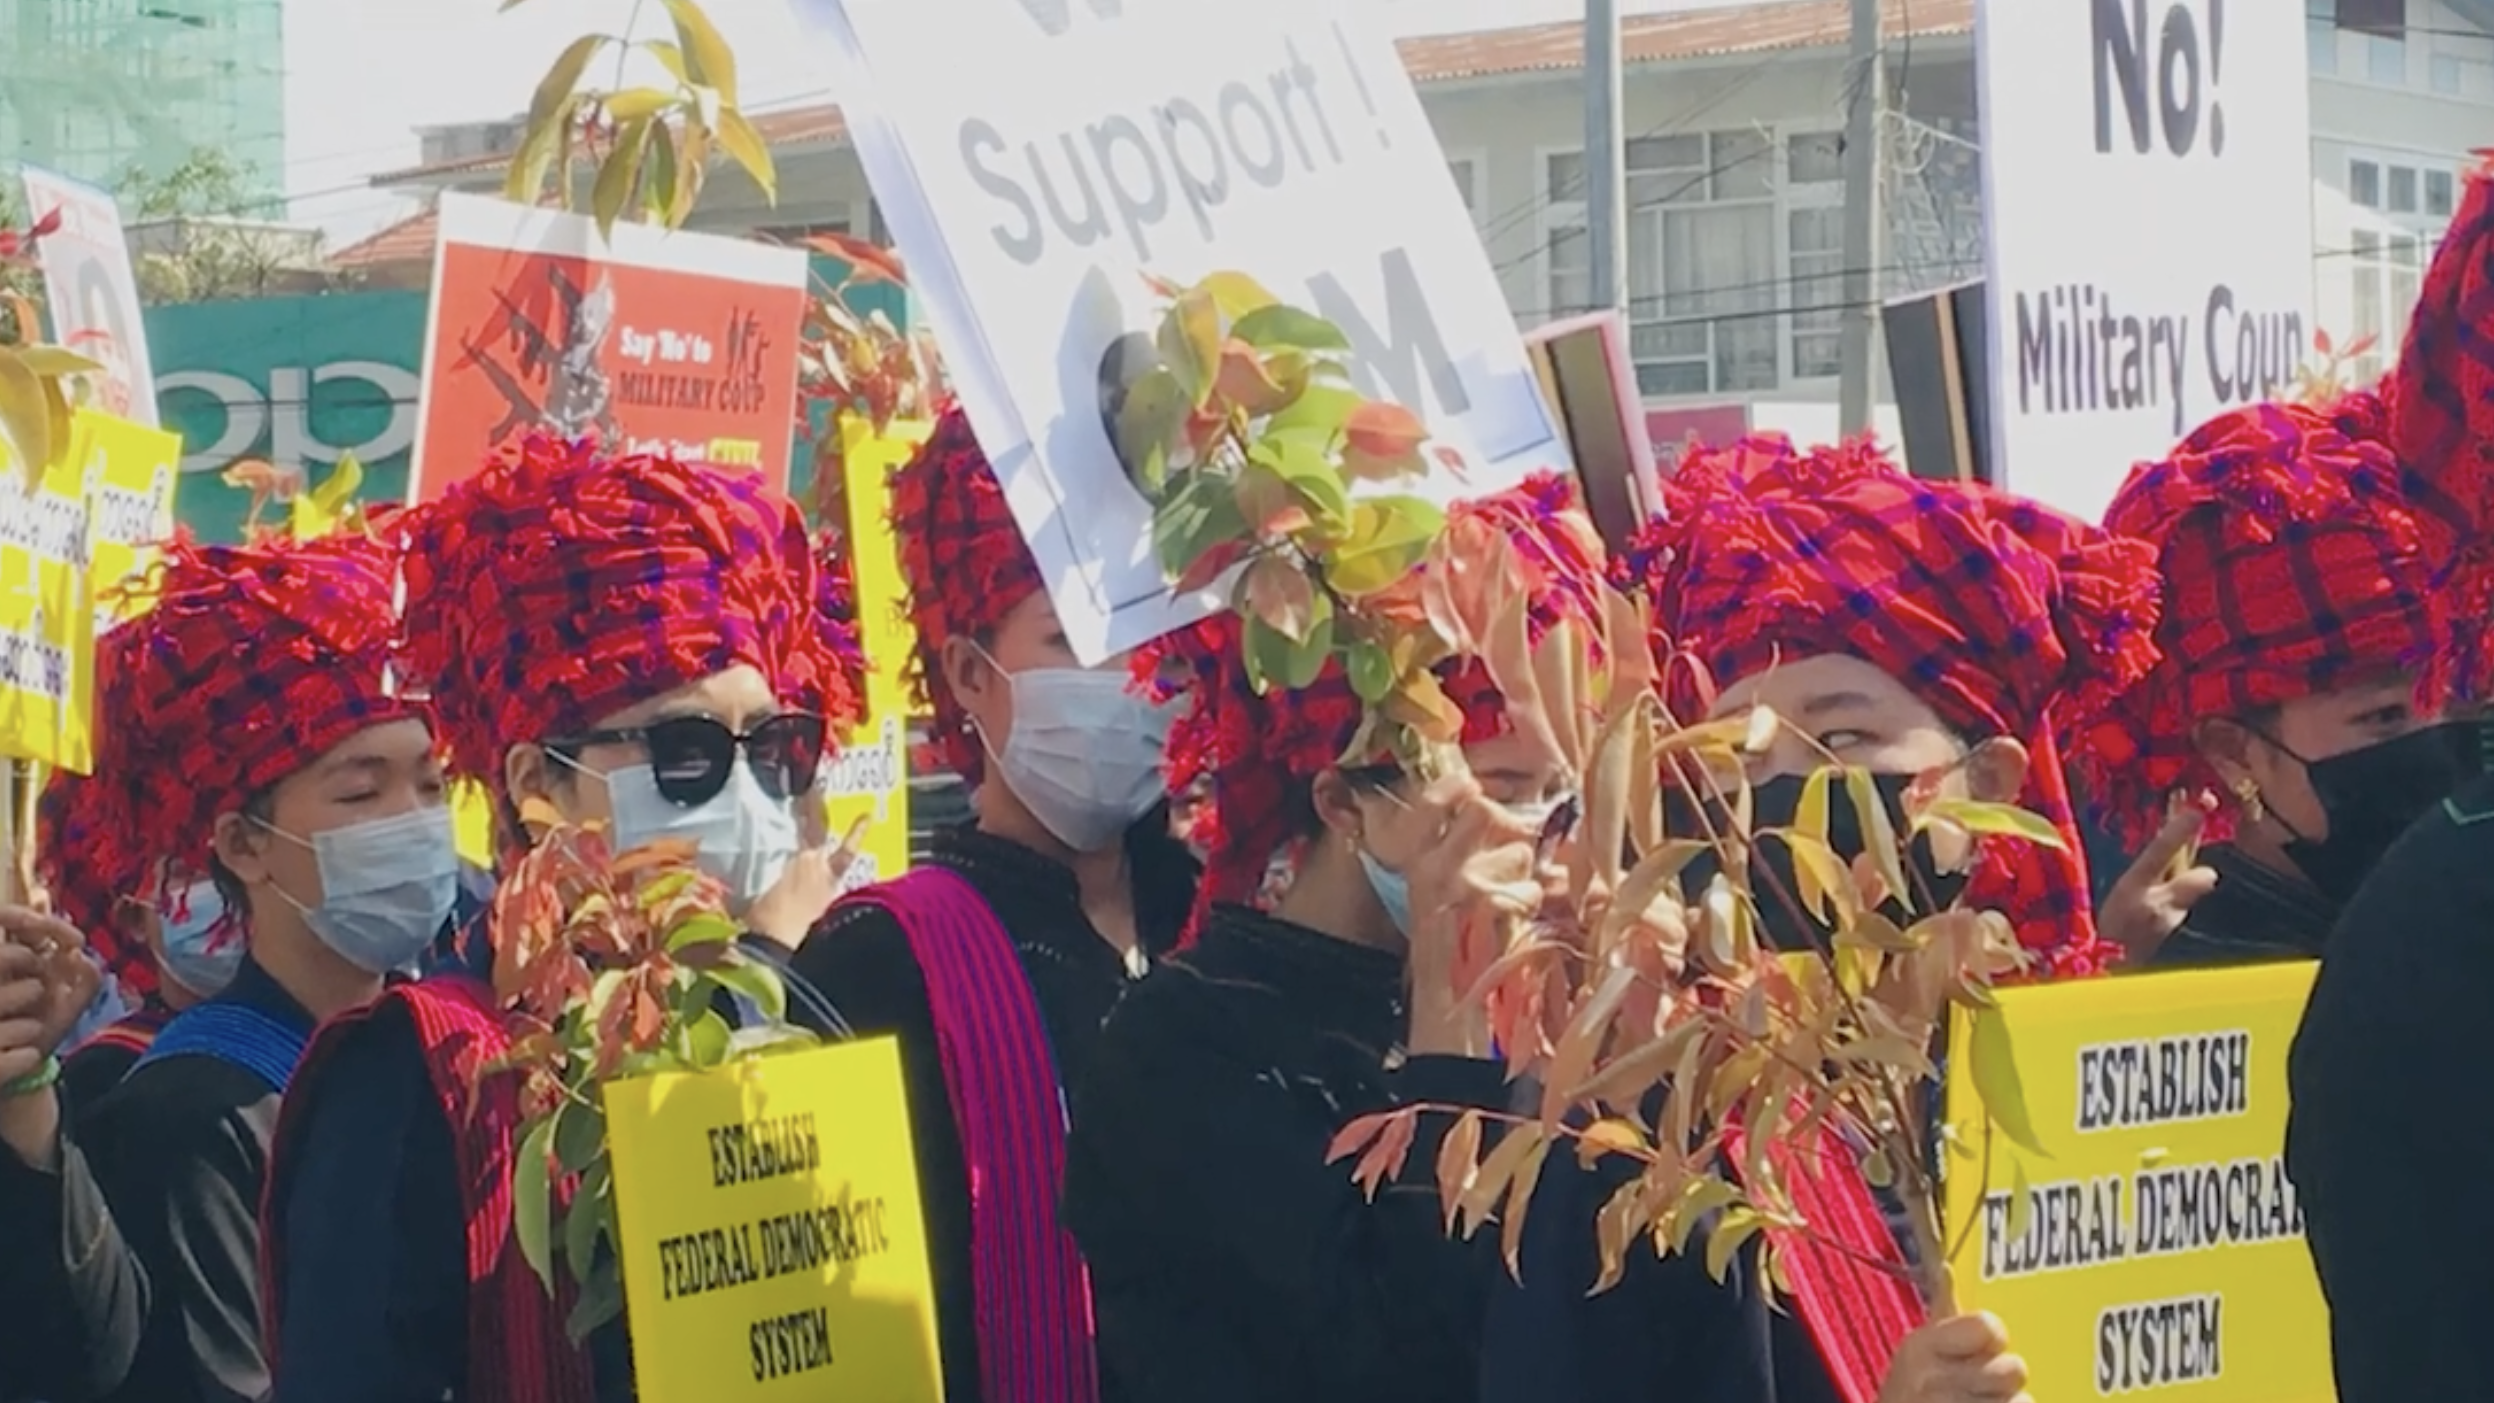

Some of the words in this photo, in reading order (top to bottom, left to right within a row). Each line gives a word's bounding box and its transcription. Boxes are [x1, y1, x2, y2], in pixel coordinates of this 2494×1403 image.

[2092, 0, 2226, 158] No!
[958, 32, 1344, 266] Support
[618, 371, 716, 411] MILITARY
[718, 378, 766, 413] COUP
[2015, 283, 2188, 437] Military
[2080, 1033, 2248, 1128] ESTABLISH
[708, 1112, 820, 1186] ESTABLISH
[659, 1223, 759, 1301] FEDERAL
[762, 1196, 890, 1280] DEMOCRATIC
[749, 1307, 834, 1382] SYSTEM
[2099, 1297, 2222, 1392] SYSTEM
